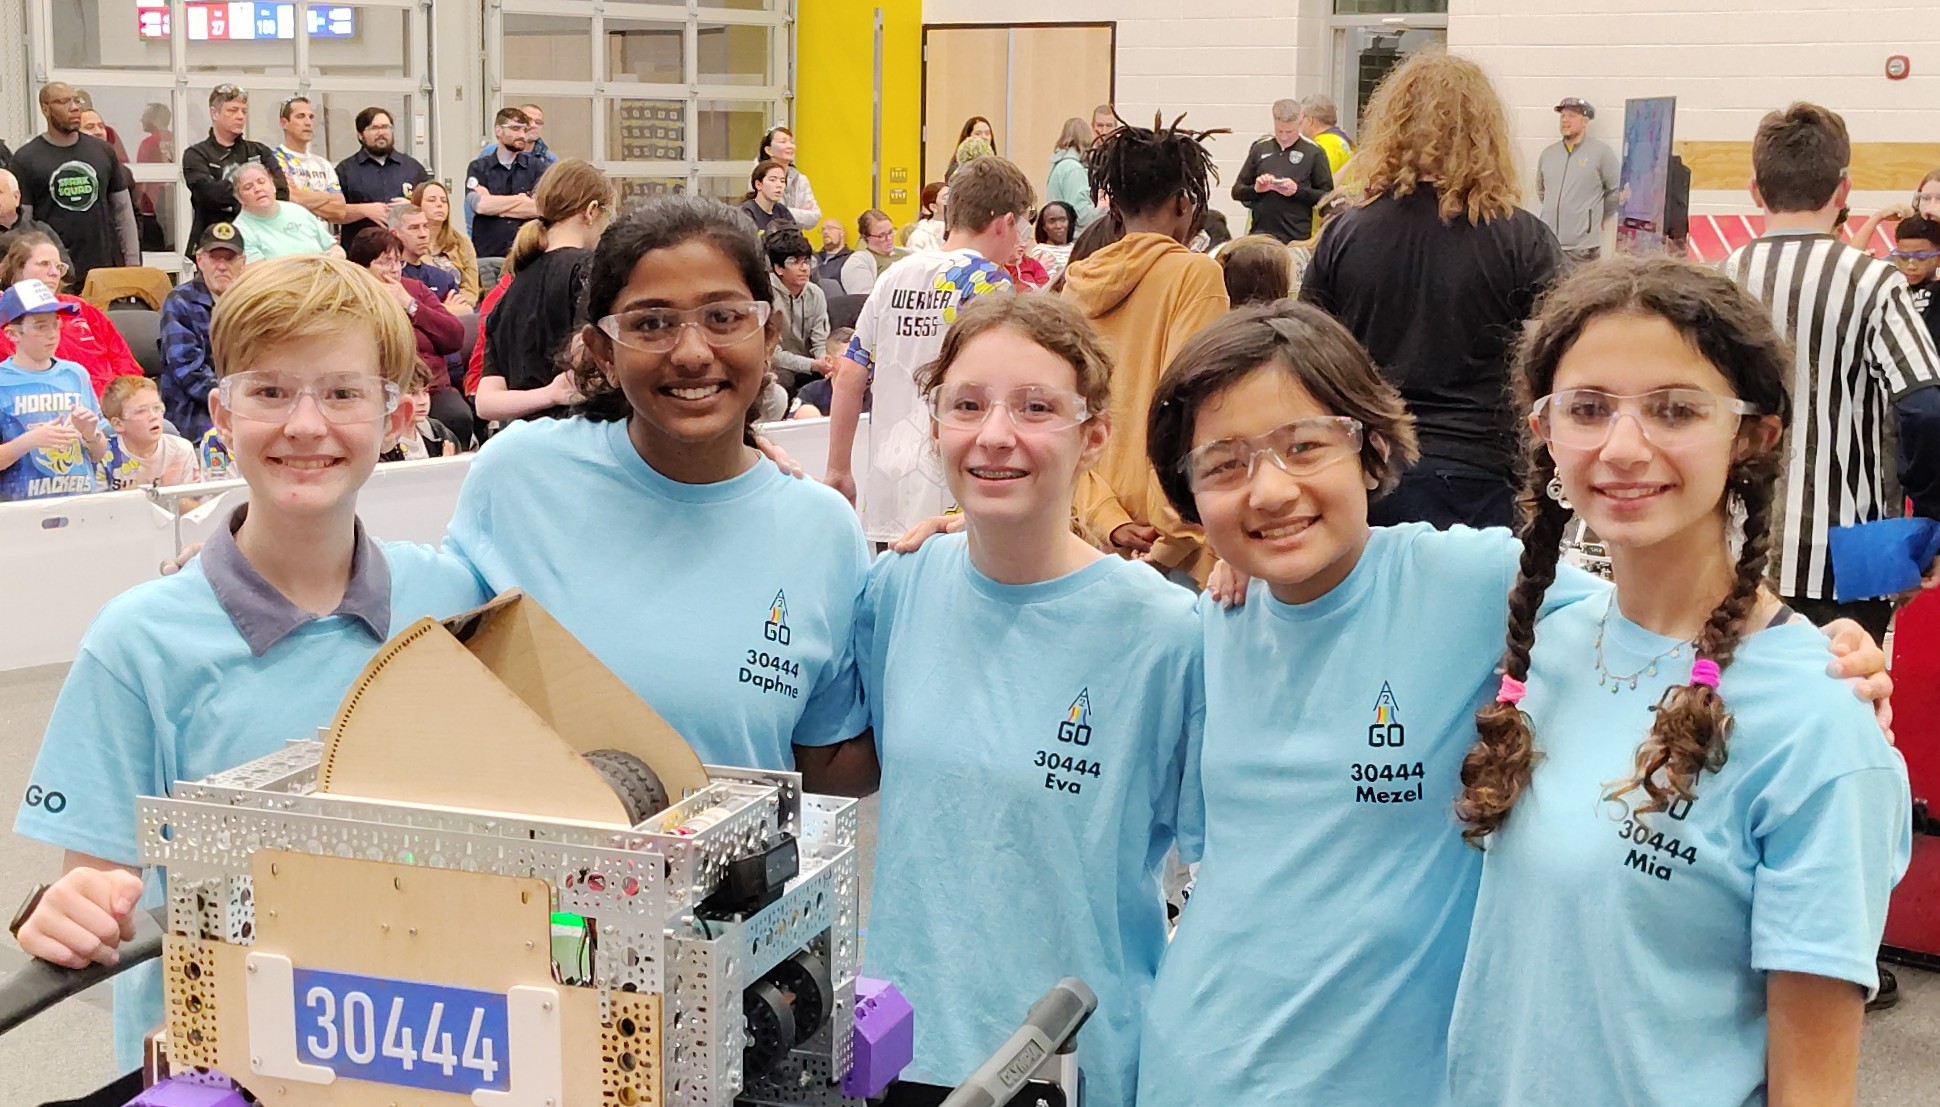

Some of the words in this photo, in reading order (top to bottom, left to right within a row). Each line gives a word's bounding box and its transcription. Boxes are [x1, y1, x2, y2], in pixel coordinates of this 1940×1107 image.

[14, 392, 82, 416] HORNET
[27, 474, 93, 497] HACKERS
[764, 620, 791, 646] GO
[746, 649, 800, 679] 30444
[738, 667, 799, 699] Daphne
[1057, 720, 1093, 747] GO
[1368, 723, 1405, 748] GO
[1033, 749, 1102, 779] 30444
[1350, 762, 1426, 783] 30444
[1044, 772, 1082, 795] Eva
[1355, 781, 1424, 804] Mezel
[25, 784, 67, 814] GO
[1618, 819, 1698, 866] 30444
[1623, 848, 1673, 881] Mia
[306, 986, 499, 1082] 30444
